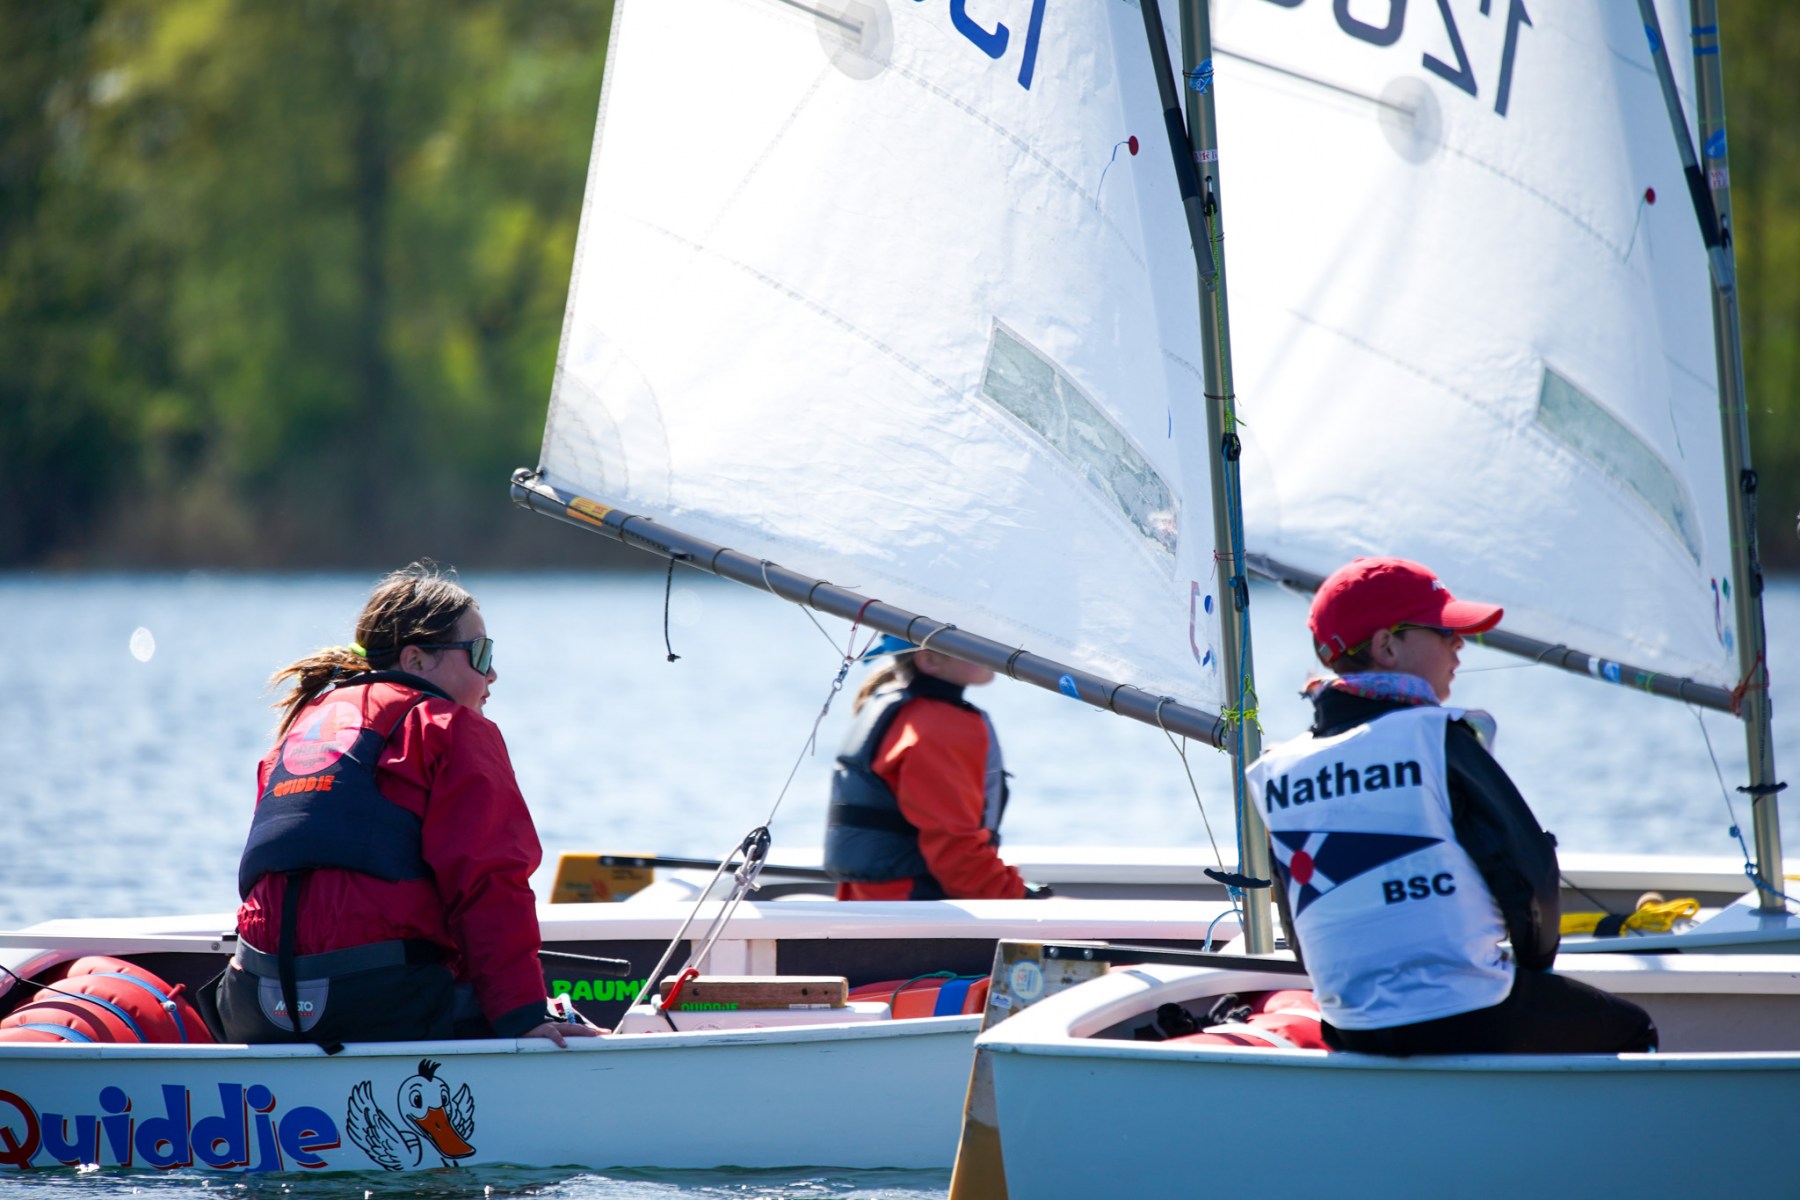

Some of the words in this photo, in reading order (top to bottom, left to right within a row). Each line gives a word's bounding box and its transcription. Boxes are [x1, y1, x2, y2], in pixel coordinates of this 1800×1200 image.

[273, 775, 335, 797] QUIDDJE
[1265, 760, 1422, 813] Nathan
[1382, 872, 1456, 905] BSC
[274, 1000, 314, 1012] MSTO
